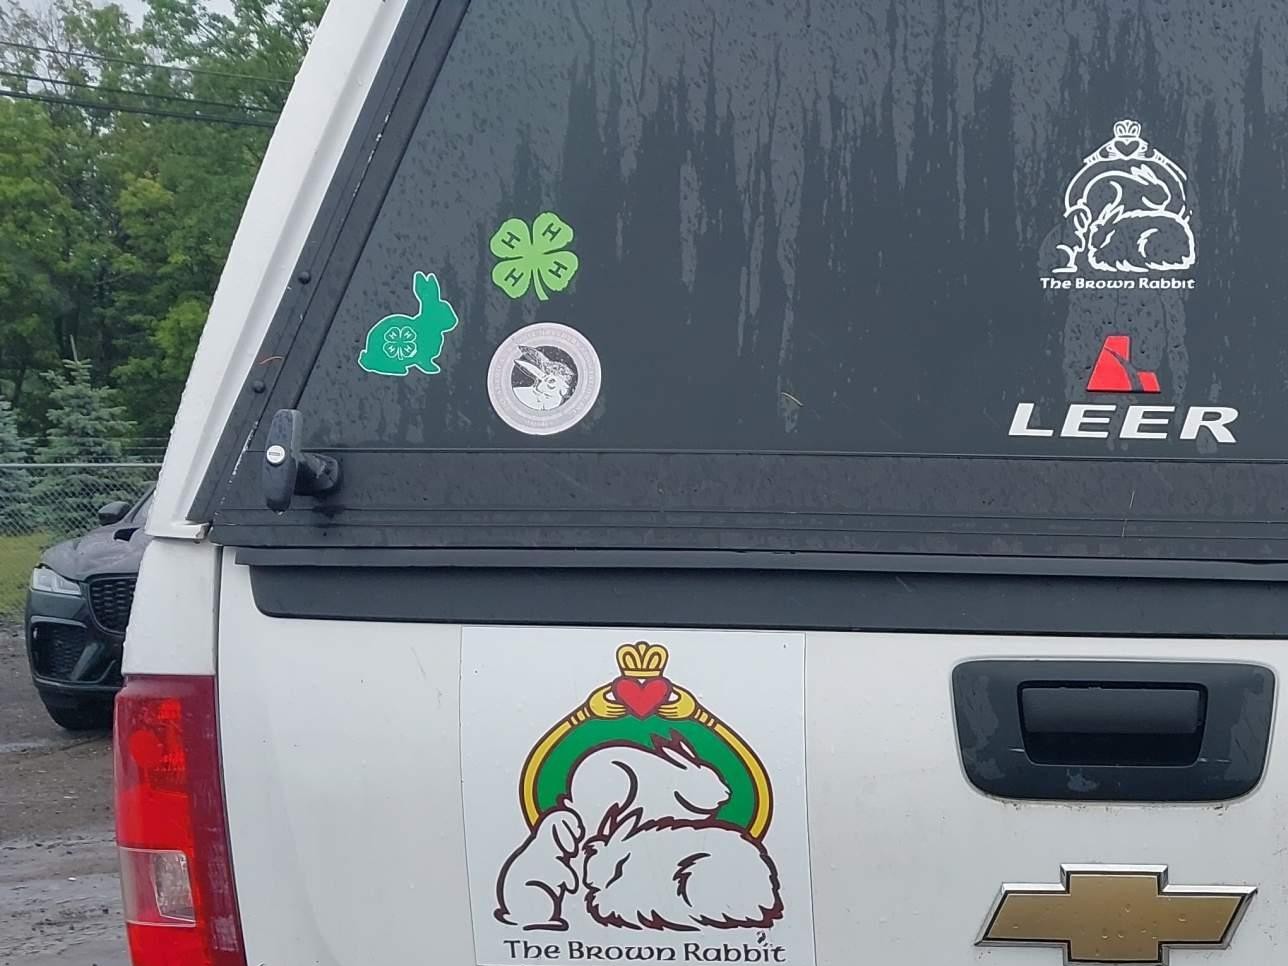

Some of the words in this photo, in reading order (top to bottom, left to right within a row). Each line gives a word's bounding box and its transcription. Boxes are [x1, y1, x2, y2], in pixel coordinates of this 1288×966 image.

[501, 231, 521, 250] H
[542, 222, 562, 242] H
[504, 267, 524, 287] H
[548, 260, 568, 279] H
[1039, 277, 1072, 289] The
[1075, 277, 1135, 289] Brown
[1139, 277, 1196, 289] Rabbit
[1008, 402, 1239, 444] LEER
[503, 940, 561, 959] The
[567, 940, 677, 961] Brown
[683, 941, 787, 963] Rabbit
